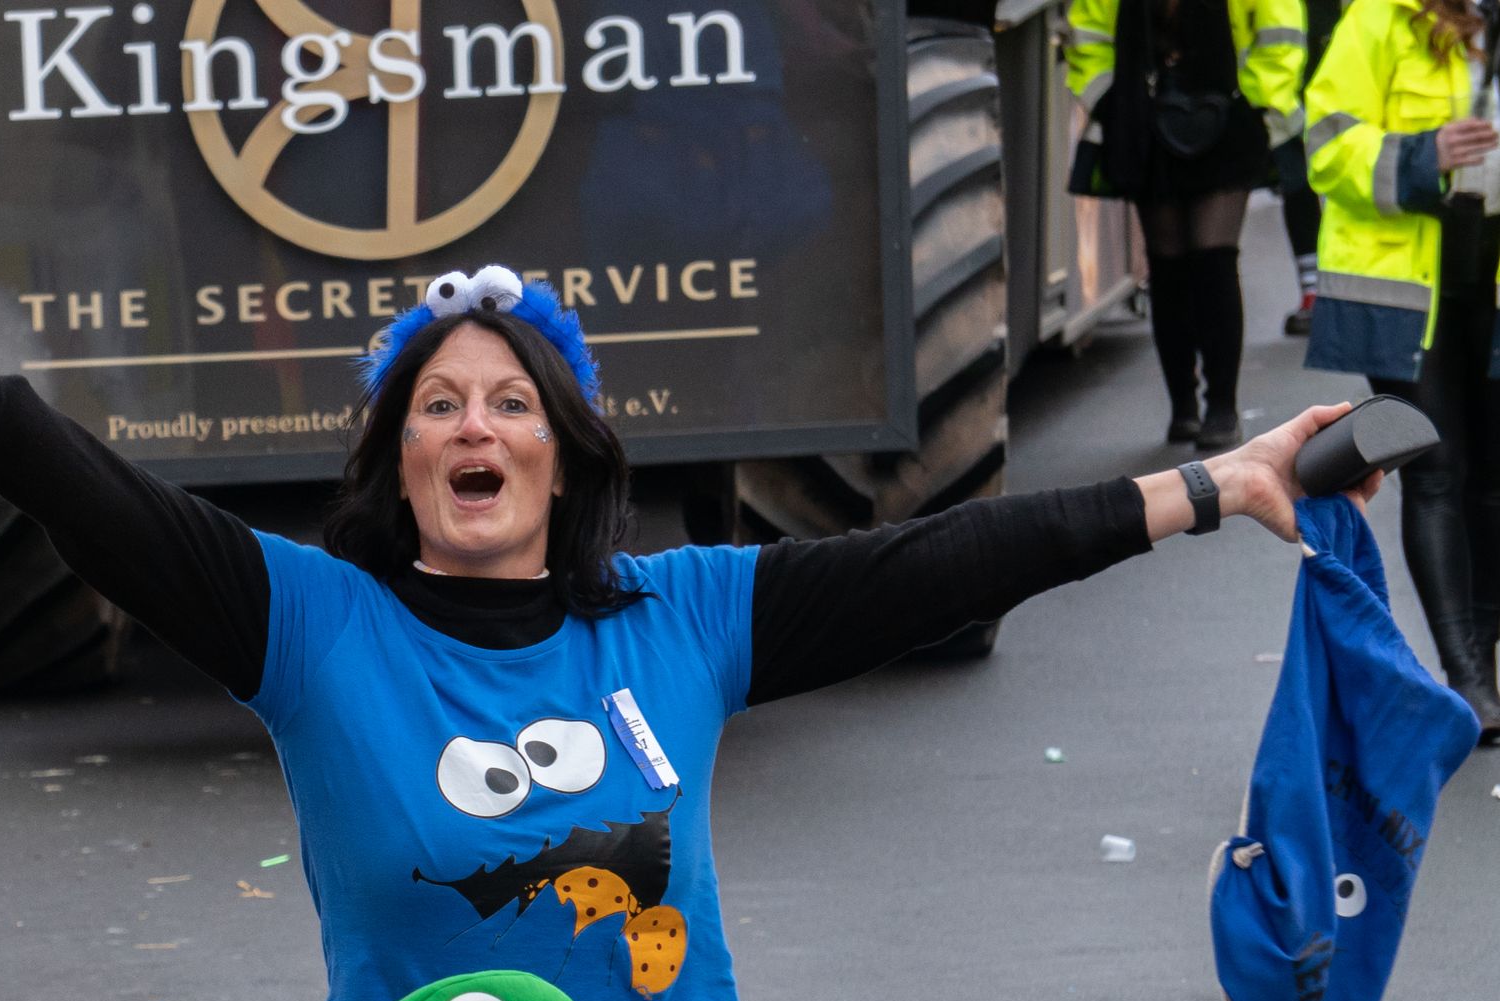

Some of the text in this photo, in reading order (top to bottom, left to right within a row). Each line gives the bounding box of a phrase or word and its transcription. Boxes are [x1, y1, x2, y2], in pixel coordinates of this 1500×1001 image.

[3, 2, 757, 134] Kingsman
[18, 290, 150, 333] THE
[523, 259, 760, 308] RVICE
[107, 411, 214, 442] Proudly
[221, 403, 355, 441] presented
